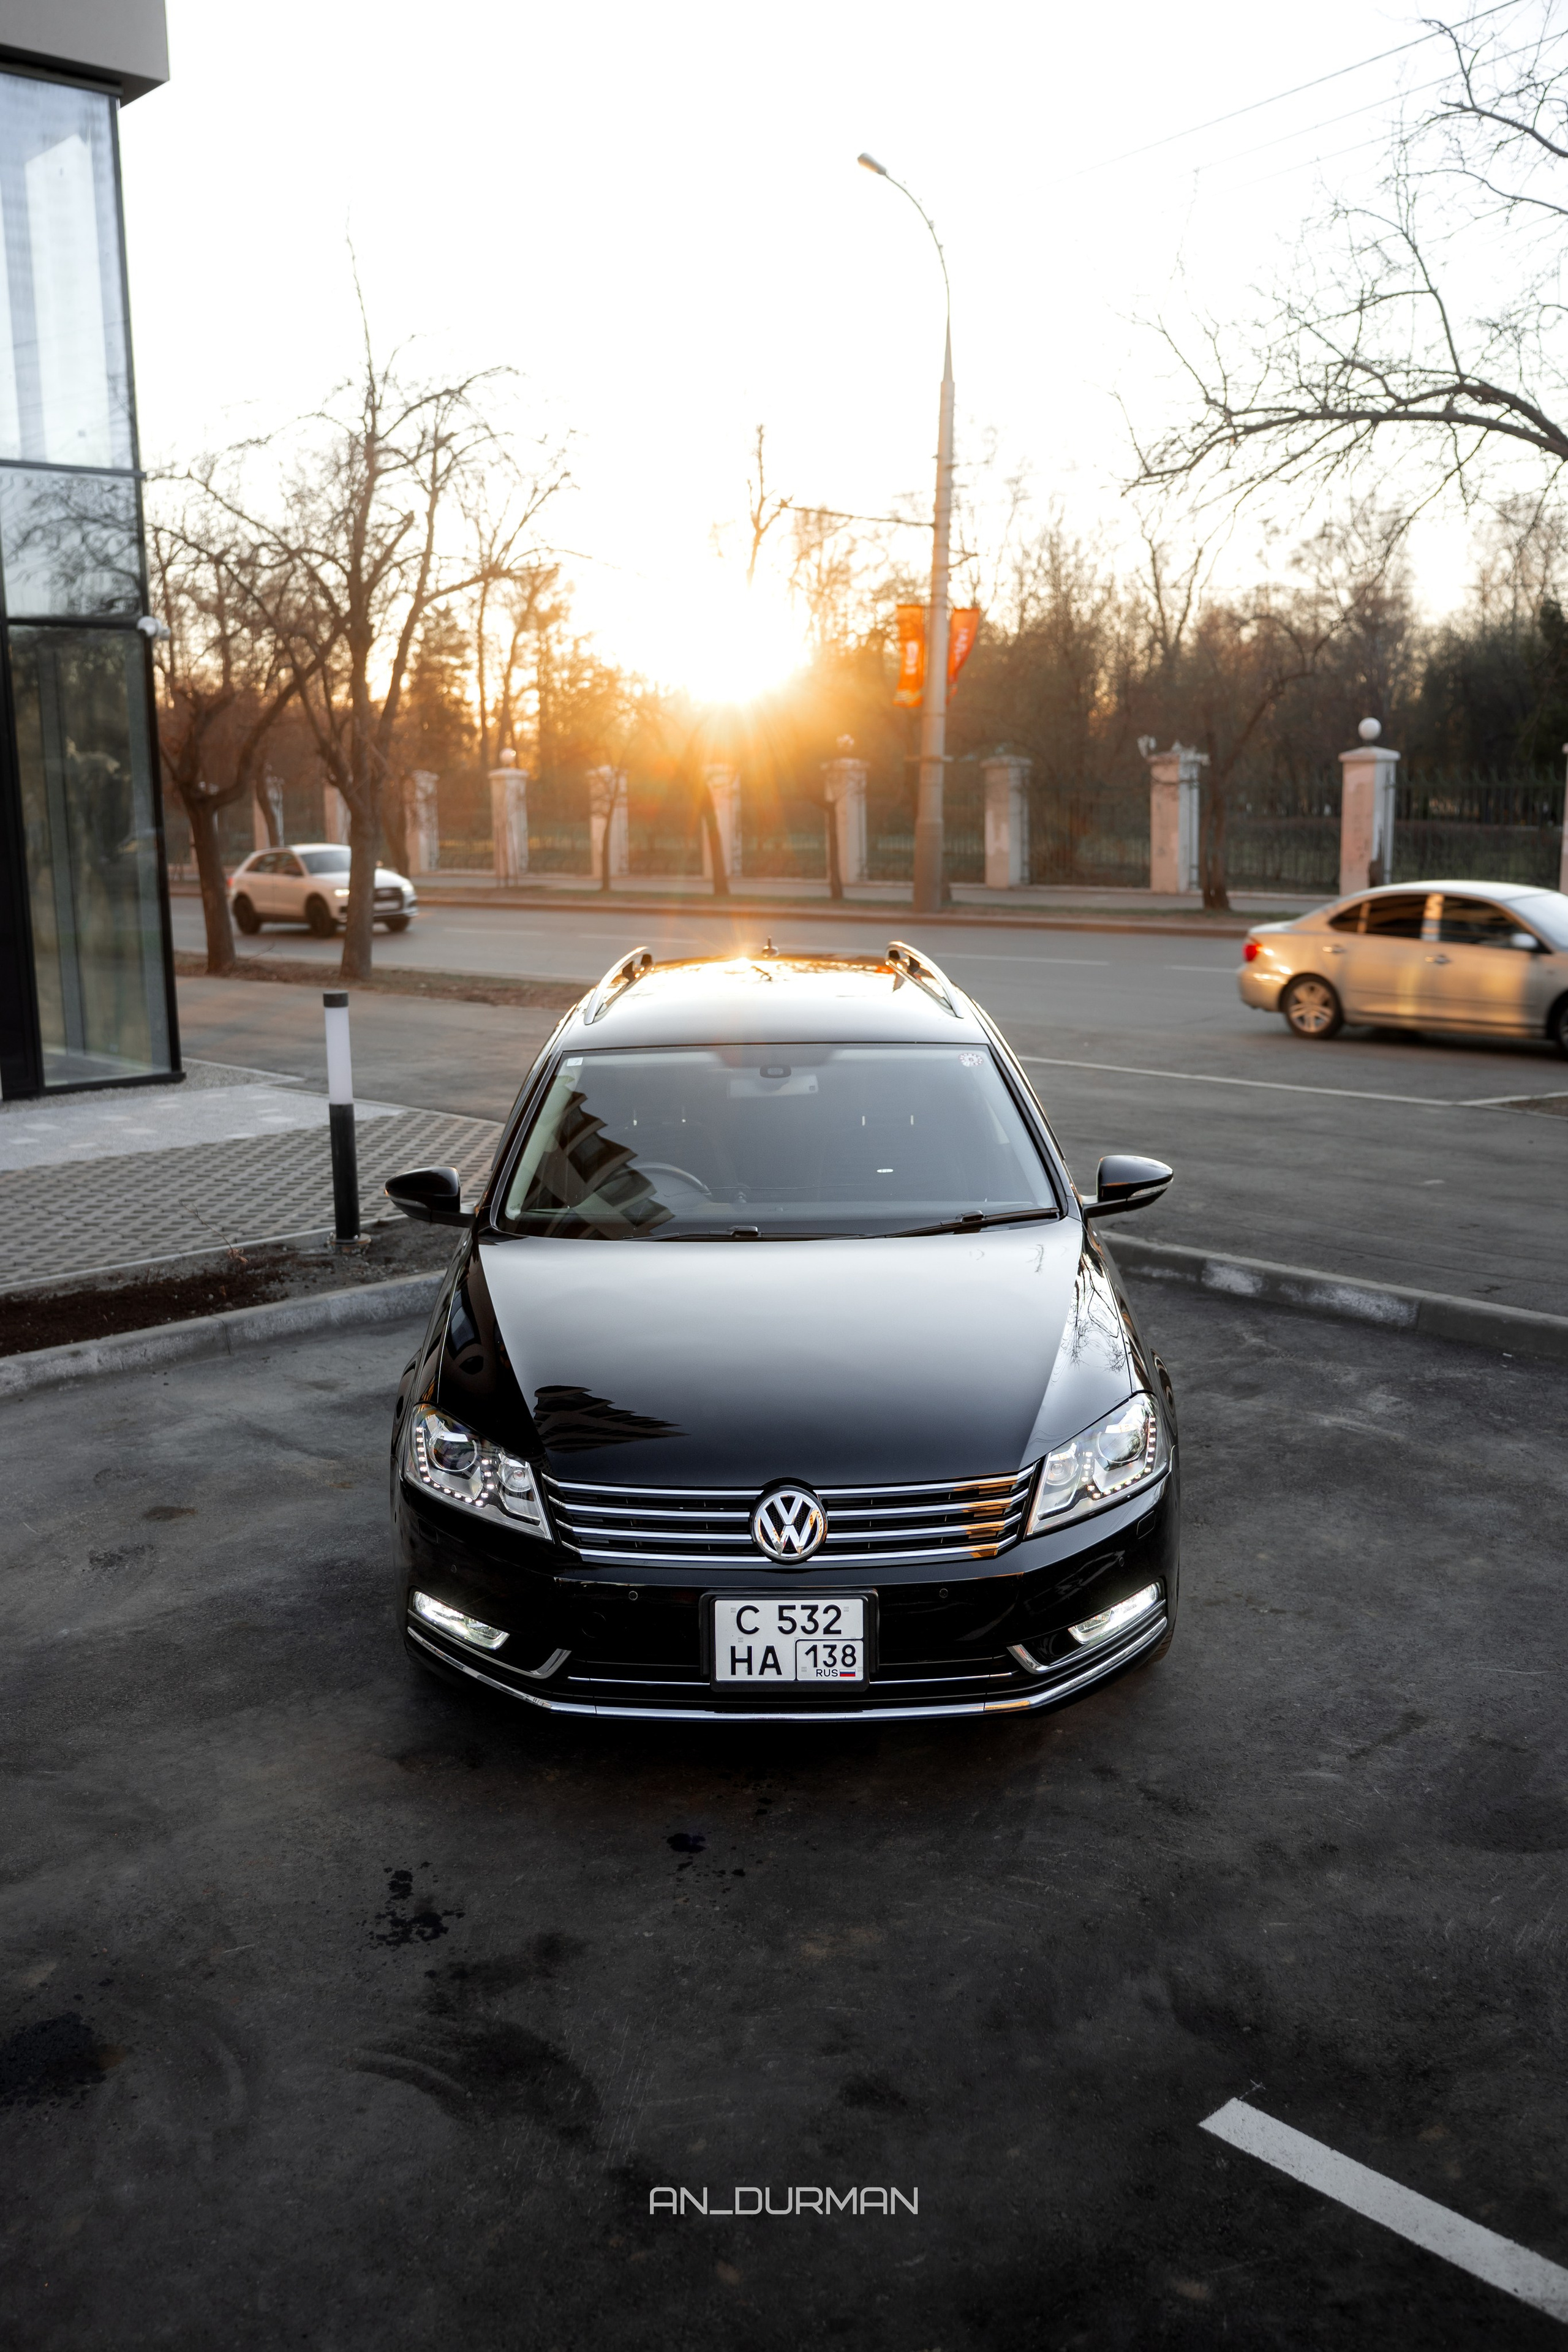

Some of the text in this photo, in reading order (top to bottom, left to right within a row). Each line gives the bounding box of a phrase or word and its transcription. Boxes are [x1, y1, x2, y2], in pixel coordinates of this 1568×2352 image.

[777, 1604, 842, 1635] 532
[804, 1644, 857, 1668] 138
[816, 1668, 839, 1677] RUS
